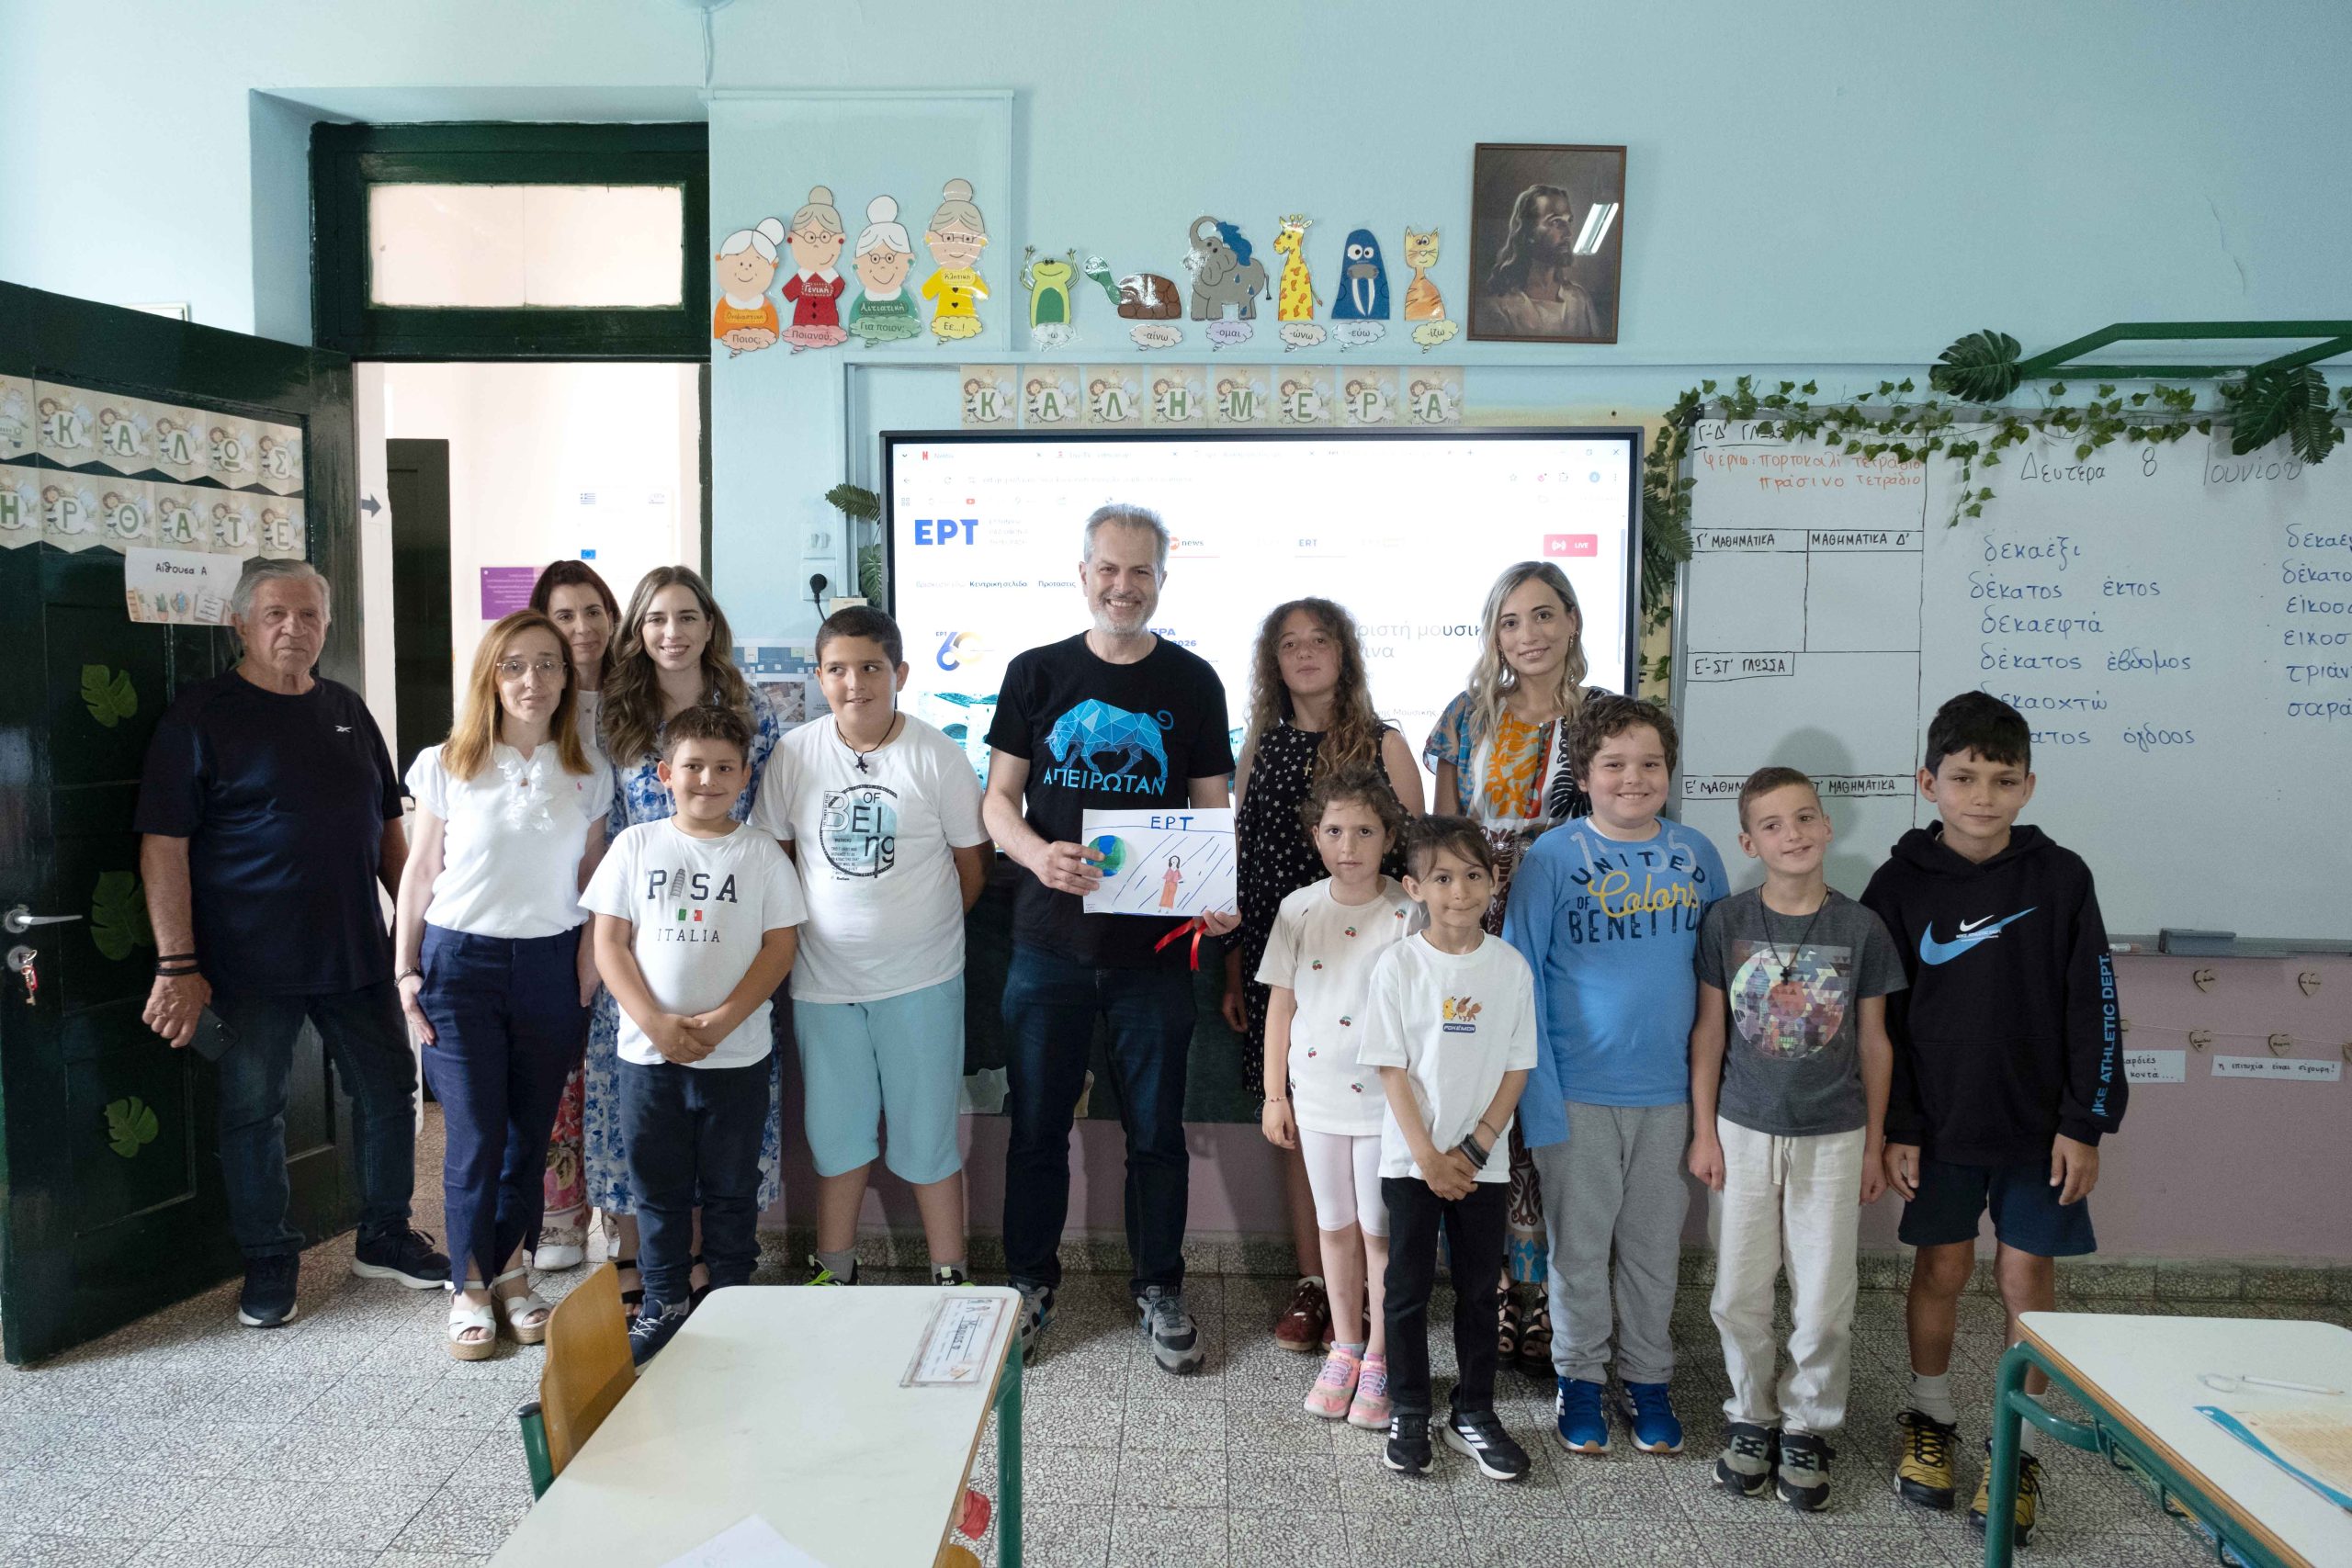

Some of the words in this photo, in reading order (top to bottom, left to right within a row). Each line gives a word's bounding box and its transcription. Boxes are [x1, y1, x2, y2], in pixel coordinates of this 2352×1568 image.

[860, 321, 873, 330] Για
[732, 333, 761, 344] Ποιος;
[791, 330, 832, 342] Ποιανού;
[1143, 331, 1169, 342] -αίνω
[1216, 329, 1241, 339] -ομαι
[1289, 329, 1314, 340] -ώνω
[1347, 329, 1371, 339] -εύω
[2142, 446, 2157, 477] 8
[1758, 470, 1845, 491] πράσινο
[1856, 472, 1921, 491] τετράδιο
[914, 518, 979, 546] ΕΡΤ
[1812, 532, 1888, 547] ΜΑΘΗΜΑΤΙΚΑ
[1298, 538, 1317, 547] ERT
[1712, 534, 1775, 548] ΜΑΘΗΜΑΤΙΚΑ
[1984, 534, 2082, 571] δεκαέξι
[1968, 570, 2064, 600] δέκατος
[2102, 575, 2162, 598] έκτος
[1981, 604, 2105, 640] δεκαεφτά
[1742, 658, 1786, 673] ΓΛΩΣΣΑ
[1980, 643, 2083, 671] δέκατος
[2106, 648, 2192, 675] έβδομος
[2285, 661, 2352, 686] τριάν
[2029, 730, 2092, 745] ατος
[2123, 721, 2196, 752] όγδοος
[1043, 766, 1167, 797] ΑΠΕΙΡΩΤΑΝ
[1828, 779, 1895, 794] ΜΑΘΗΜΑΤΙΚΑ
[863, 791, 881, 804] OF
[1150, 816, 1194, 831] ΕΡΤ
[1569, 851, 1706, 886] UNITED
[1587, 871, 1699, 919] Colors
[1577, 896, 1591, 910] OF
[657, 928, 721, 944] ITALIA
[2098, 952, 2116, 999] DEPT.
[2099, 1000, 2116, 1084] ATHLETIC
[2218, 1062, 2225, 1071] η
[2232, 1061, 2264, 1073] επιτυχία
[2272, 1061, 2291, 1071] είναι
[2298, 1062, 2335, 1074] σίγουρη!
